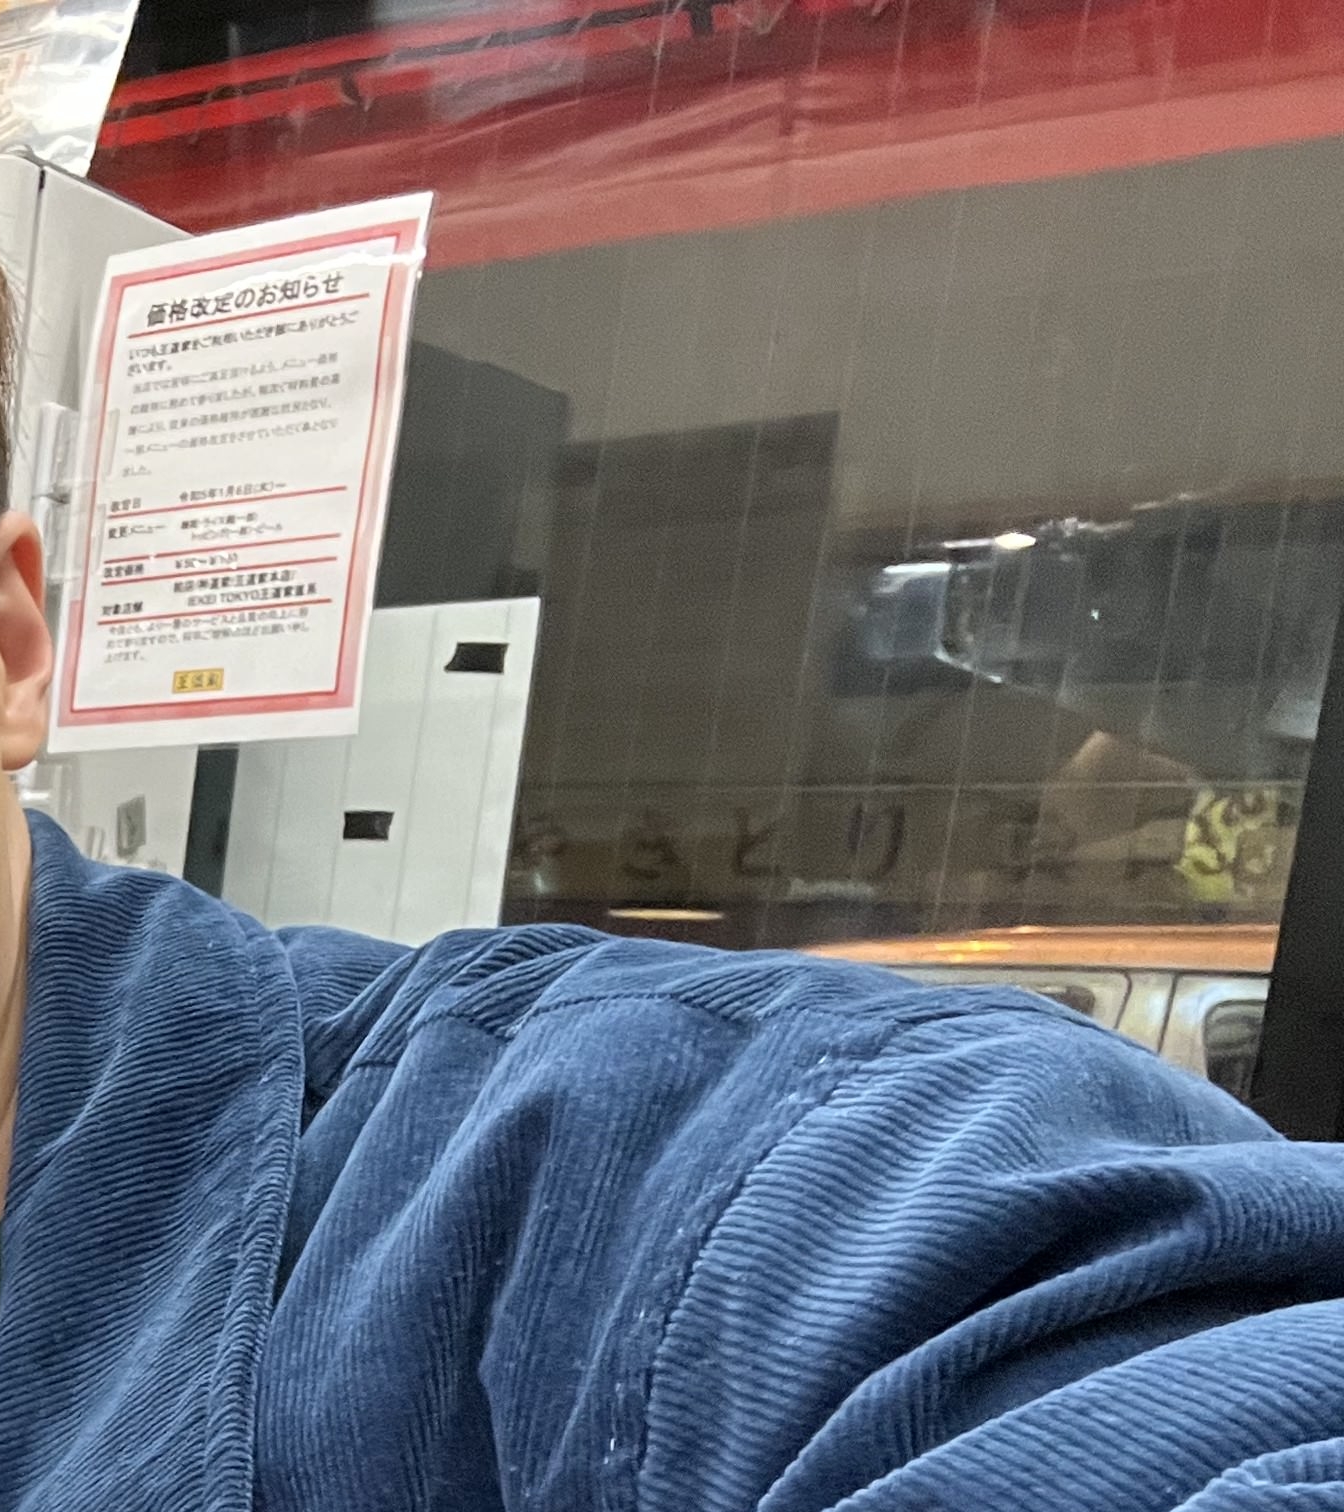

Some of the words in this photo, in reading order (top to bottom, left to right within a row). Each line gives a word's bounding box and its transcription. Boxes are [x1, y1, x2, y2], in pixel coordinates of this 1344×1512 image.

[147, 272, 344, 327] 価格改定のお知らせ
